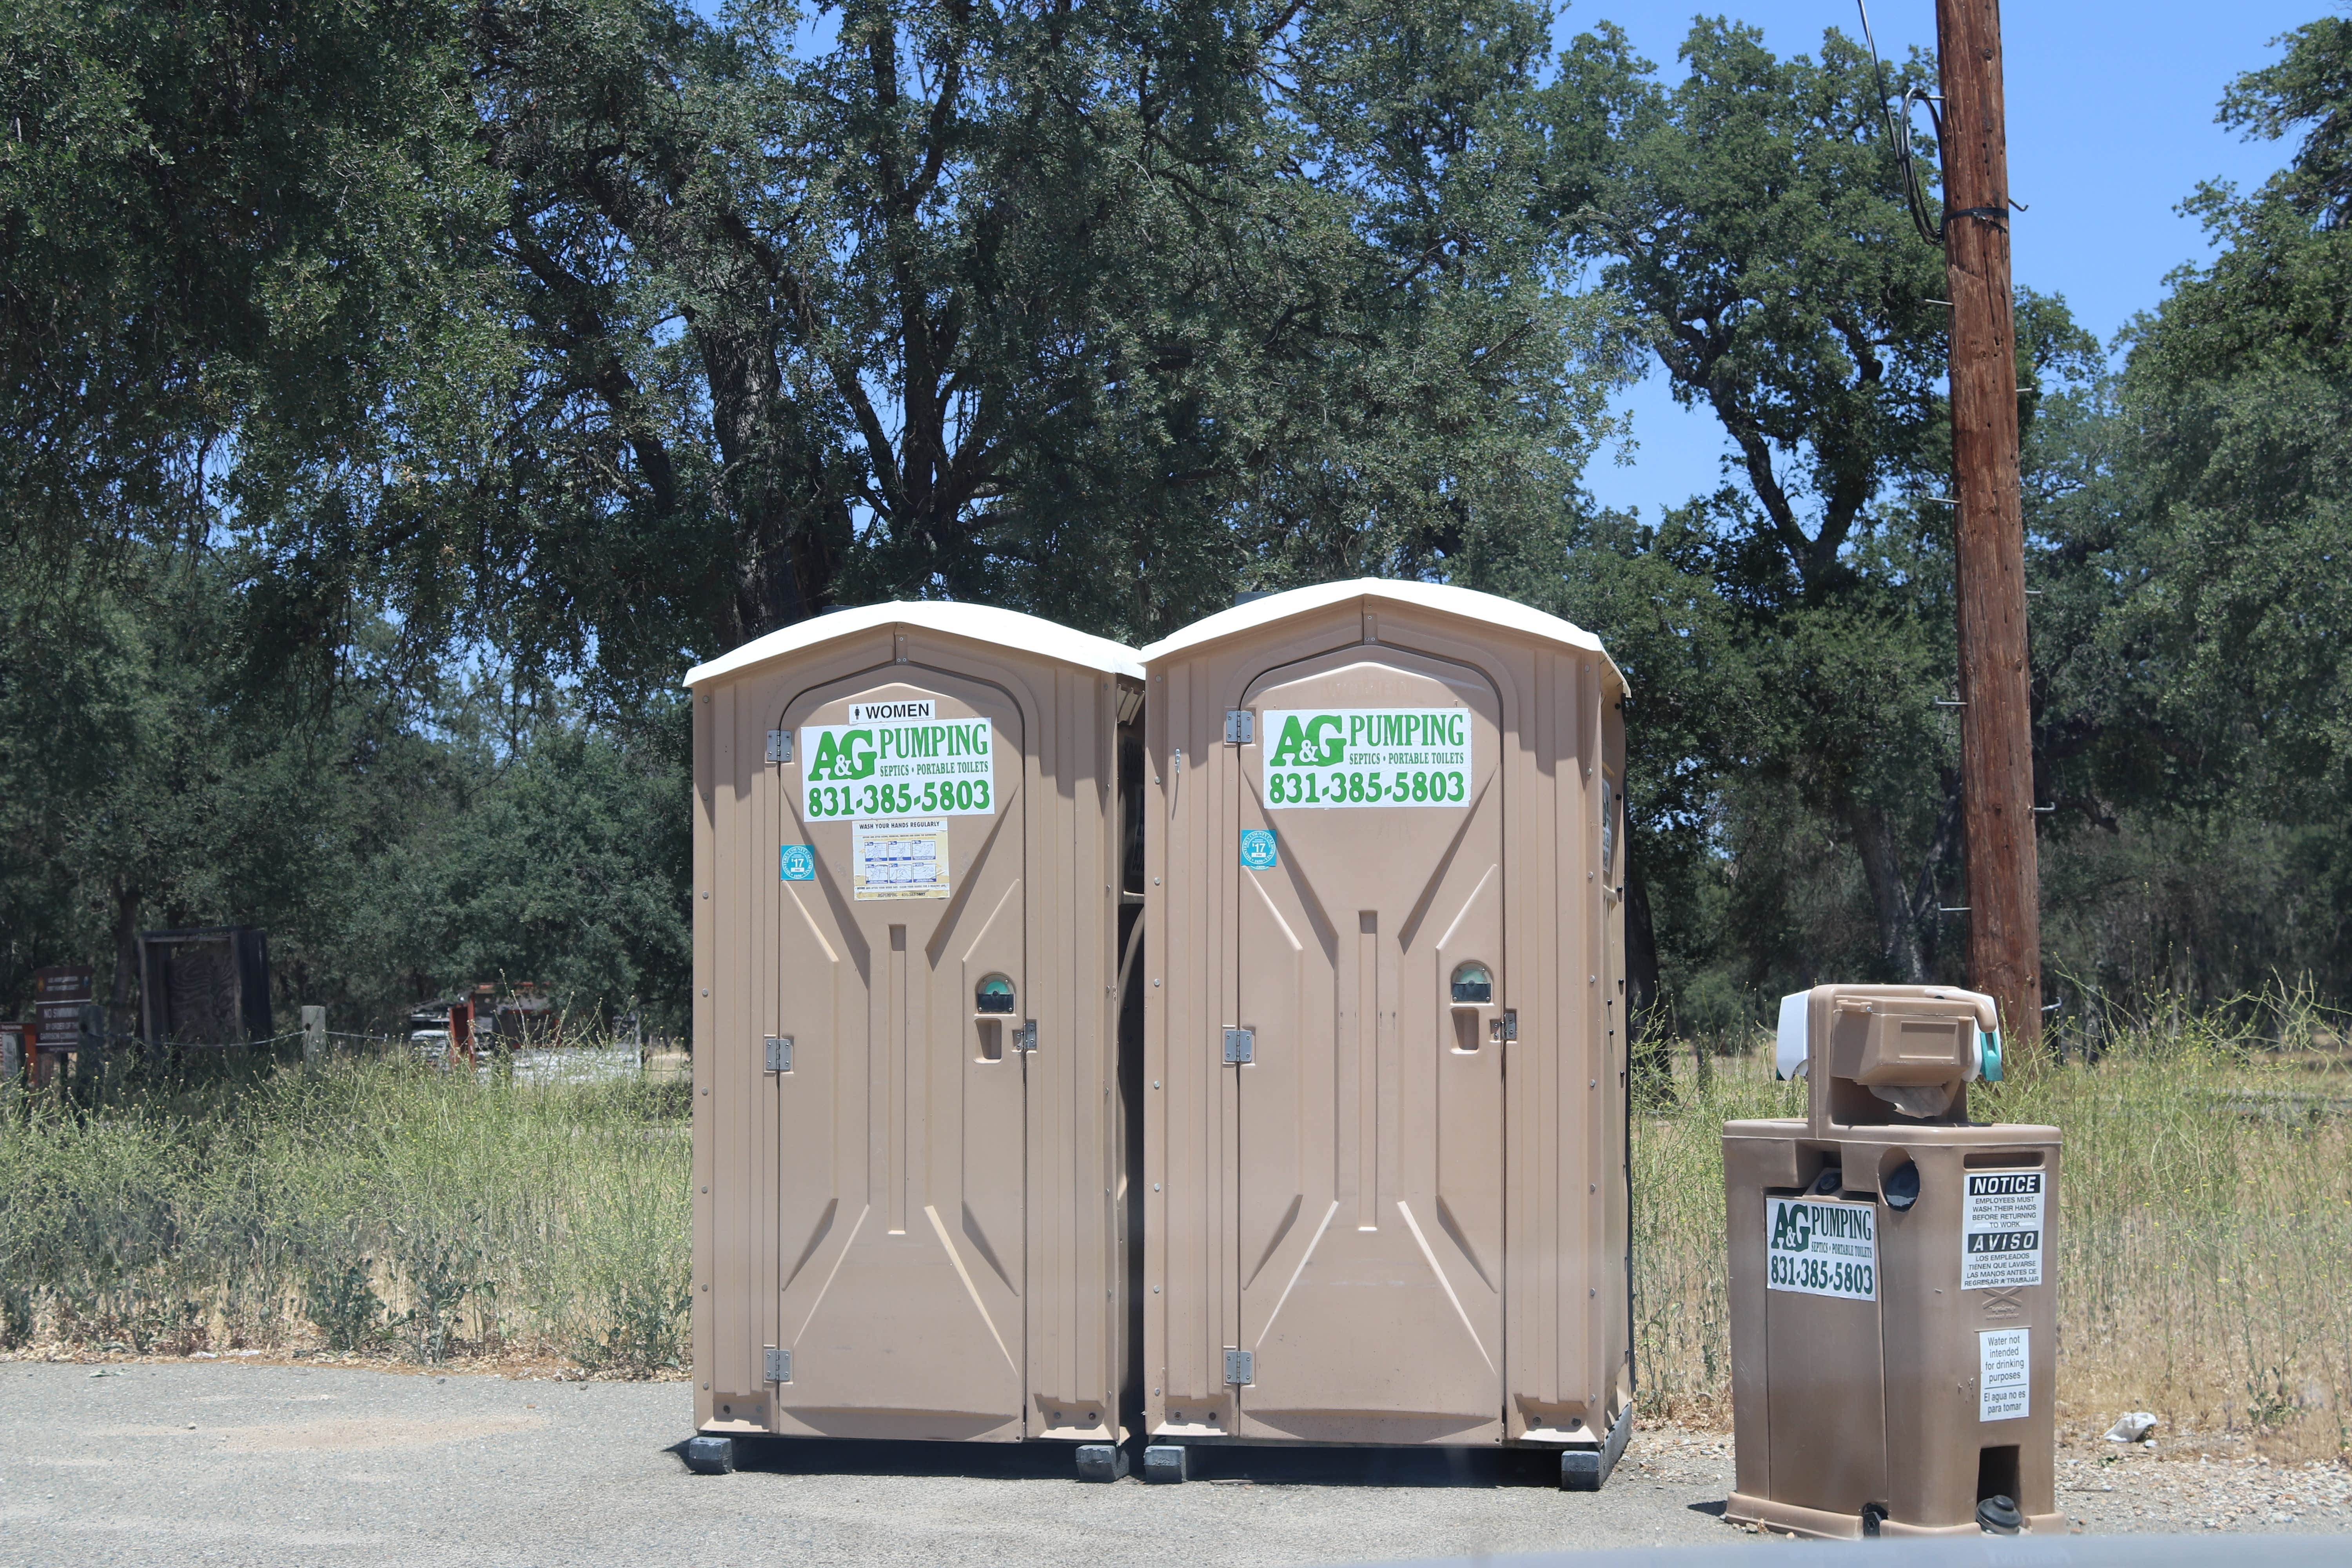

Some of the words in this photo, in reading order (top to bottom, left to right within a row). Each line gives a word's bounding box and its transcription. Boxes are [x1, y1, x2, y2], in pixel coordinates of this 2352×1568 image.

[866, 703, 929, 719] WOMEN
[1270, 715, 1347, 766] A&G
[1349, 714, 1464, 746] PUMPING
[808, 729, 877, 781] A&G
[879, 724, 988, 759] PUMPING
[1349, 753, 1380, 765] SEPTICS
[1388, 753, 1429, 765] PORTABLE
[1431, 752, 1464, 764] TOILETS
[880, 764, 909, 777] SEPTICS
[916, 762, 955, 776] PORTABLE
[957, 760, 988, 773] TOILETS
[1269, 771, 1465, 803] 831-385-5803
[809, 779, 990, 817] 831-385-5803
[1974, 1176, 2036, 1194] NOTICE
[1771, 1203, 1811, 1252] A&G
[1811, 1206, 1871, 1241] PUMPING
[1811, 1241, 1828, 1254] SEPTICS
[1832, 1243, 1854, 1256] PORTABLE
[1855, 1245, 1872, 1258] TOILETS
[1973, 1232, 2034, 1251] AVISO
[1771, 1255, 1873, 1294] 831-385-5803
[1988, 1337, 2007, 1346] Water
[2009, 1335, 2020, 1344] not
[1989, 1347, 2019, 1358] intended
[1985, 1361, 1994, 1370] for
[1996, 1358, 2024, 1369] drinking
[1989, 1372, 2021, 1384] purposes
[1984, 1393, 1990, 1402] El
[1991, 1392, 2007, 1403] agua
[1987, 1405, 2002, 1415] para
[2003, 1403, 2022, 1412] tomar
